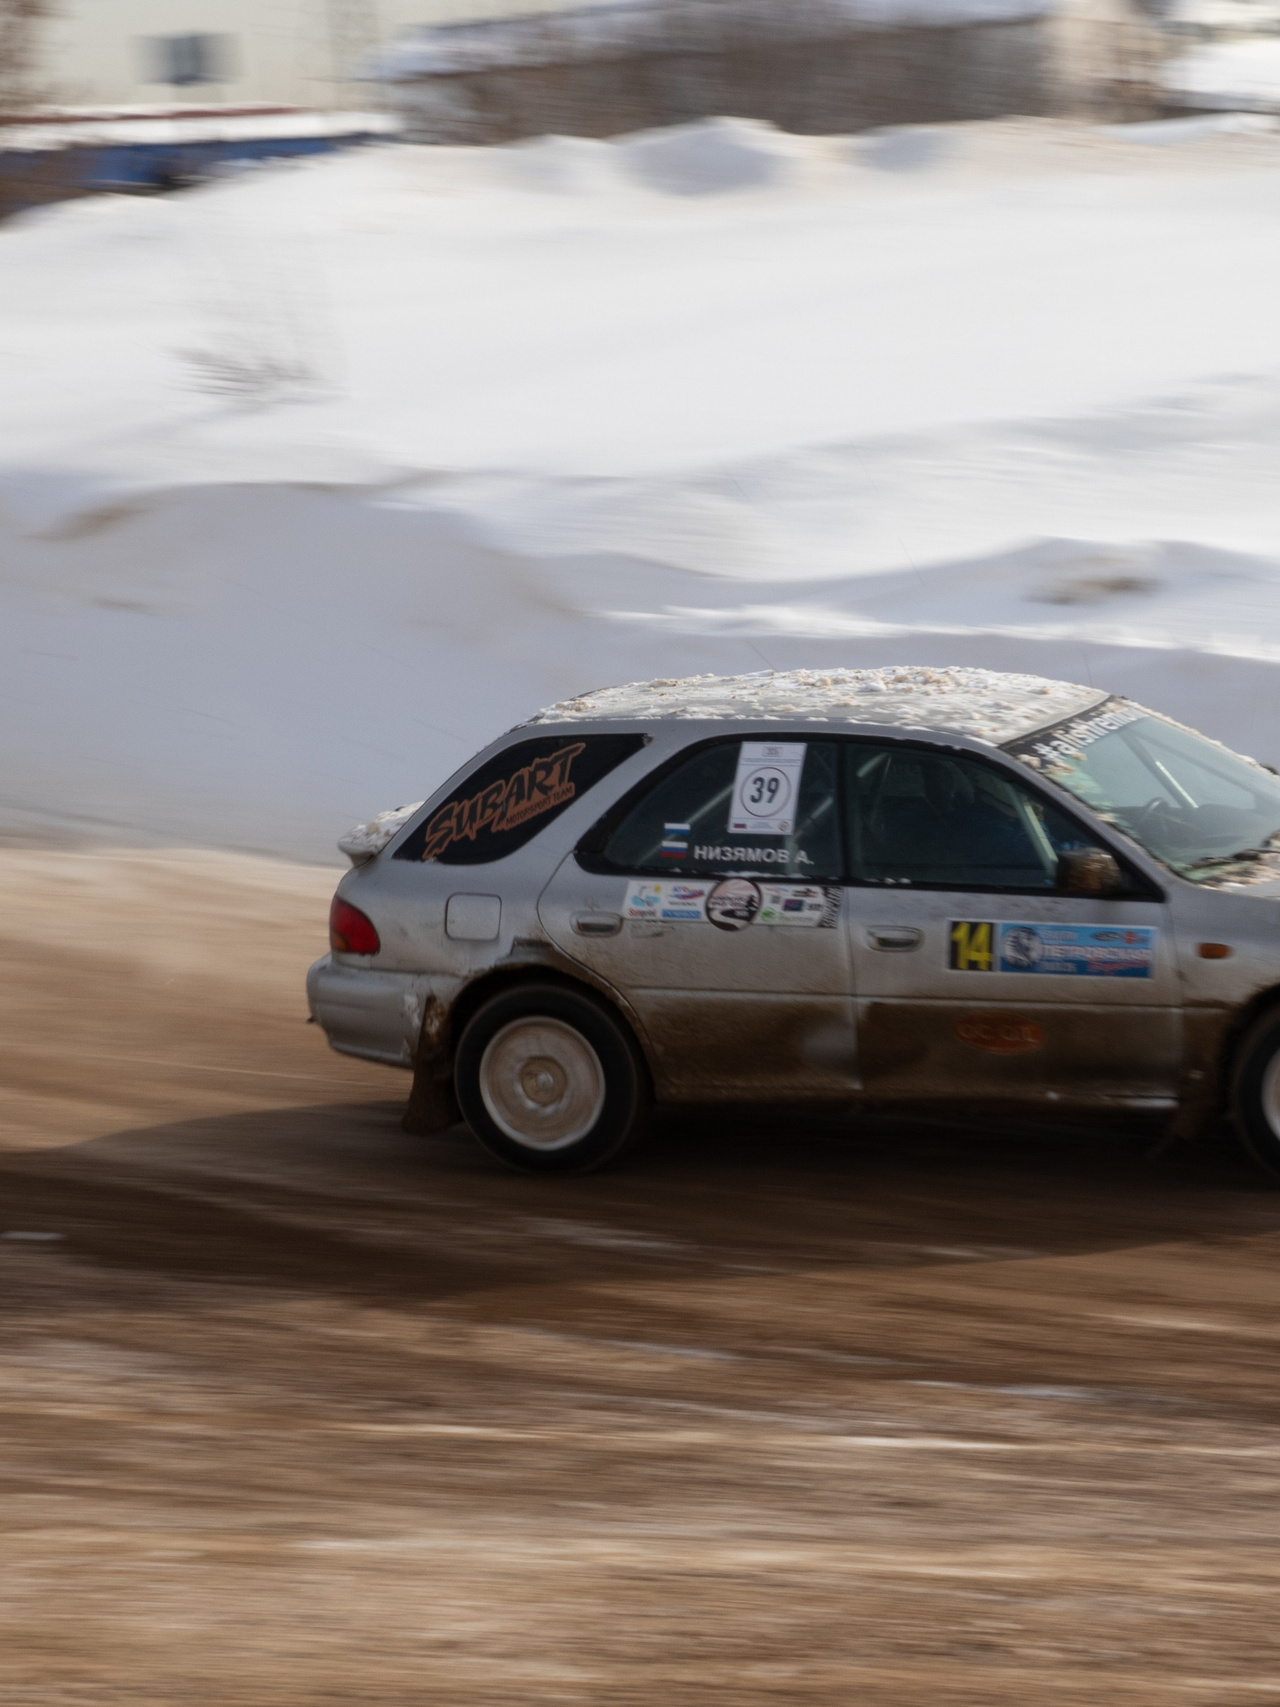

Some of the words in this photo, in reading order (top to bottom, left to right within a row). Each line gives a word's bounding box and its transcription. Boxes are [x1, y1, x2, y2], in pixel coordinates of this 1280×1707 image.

[423, 743, 586, 859] SUBART
[505, 796, 550, 827] MOTORSPORT
[552, 786, 573, 803] TEAM
[750, 777, 780, 804] 39
[693, 845, 789, 864] НИЗЯМОВ
[951, 921, 993, 971] 14
